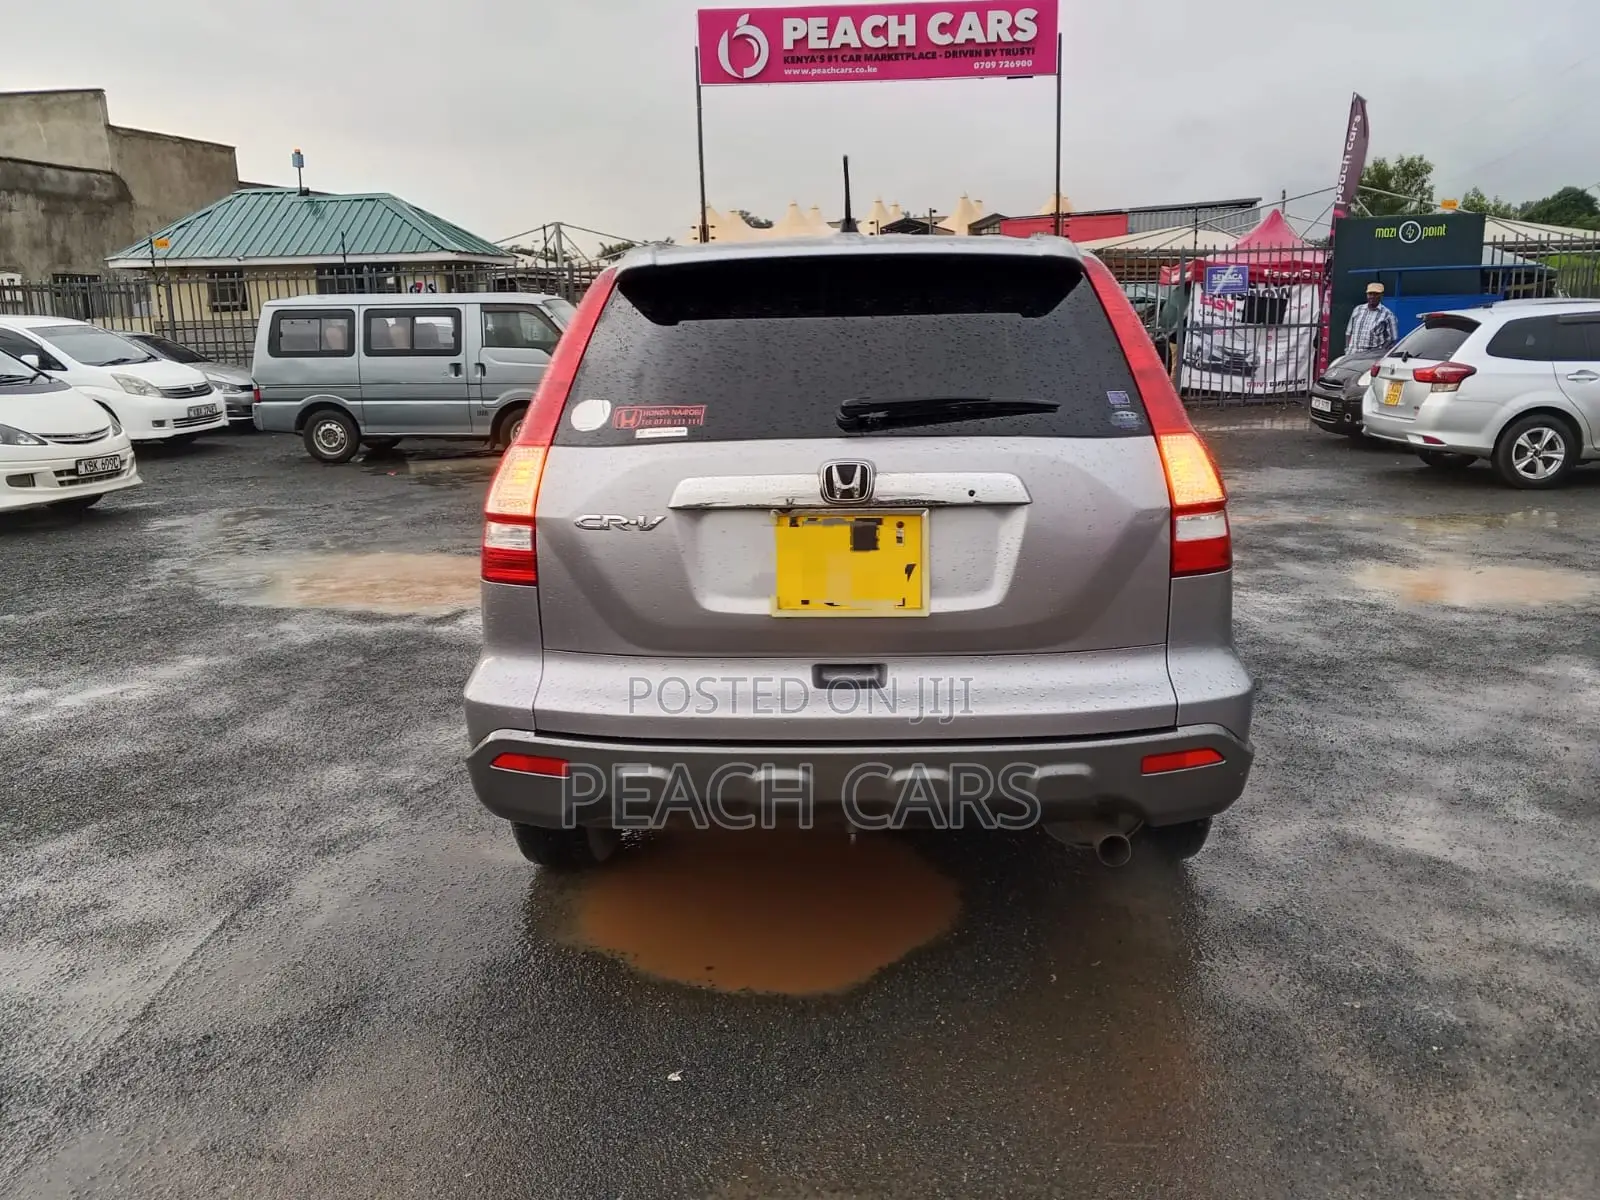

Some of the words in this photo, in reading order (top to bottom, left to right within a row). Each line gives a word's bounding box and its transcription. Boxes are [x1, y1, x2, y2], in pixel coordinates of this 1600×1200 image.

[783, 14, 916, 50] PEACH
[926, 8, 1038, 46] CARS
[783, 55, 825, 65] KENYA'S
[841, 54, 861, 63] CAR
[864, 50, 937, 62] MARKETPLACE
[944, 48, 982, 59] DRIVEN
[984, 48, 998, 57] BY
[784, 65, 878, 76] www.peachcars.co.ke
[973, 61, 997, 70] 0709
[1336, 154, 1353, 205] peach
[1346, 114, 1362, 151] cars
[1422, 223, 1447, 240] point
[642, 409, 670, 417] HONDA
[573, 514, 667, 532] CR-V
